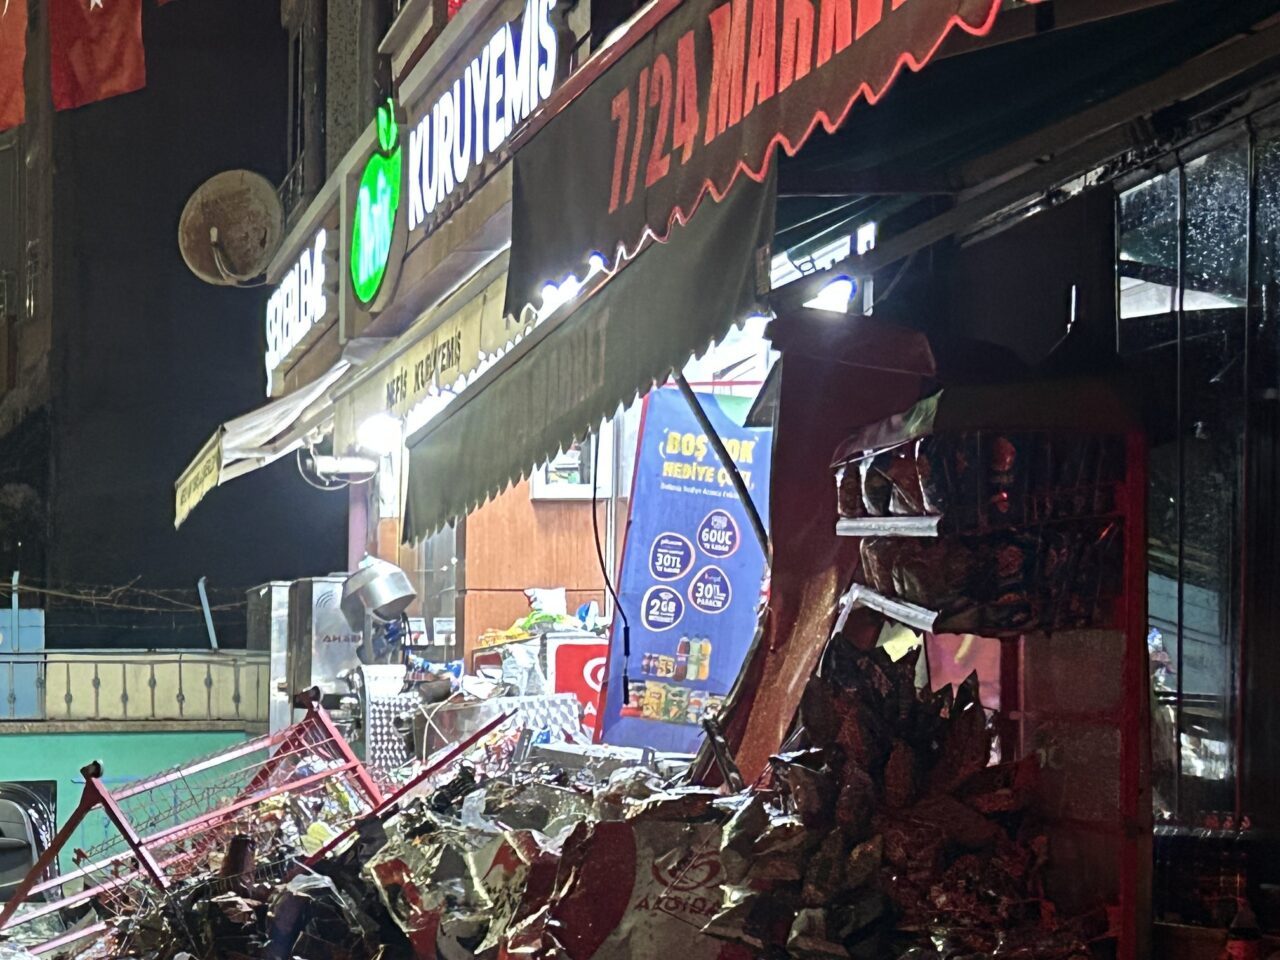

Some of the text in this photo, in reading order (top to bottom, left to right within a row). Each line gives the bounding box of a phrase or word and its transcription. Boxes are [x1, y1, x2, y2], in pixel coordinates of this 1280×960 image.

[608, 0, 906, 214] 7/24 MAR
[665, 431, 756, 464] BOŞ OK
[662, 461, 715, 483] HEDİYE
